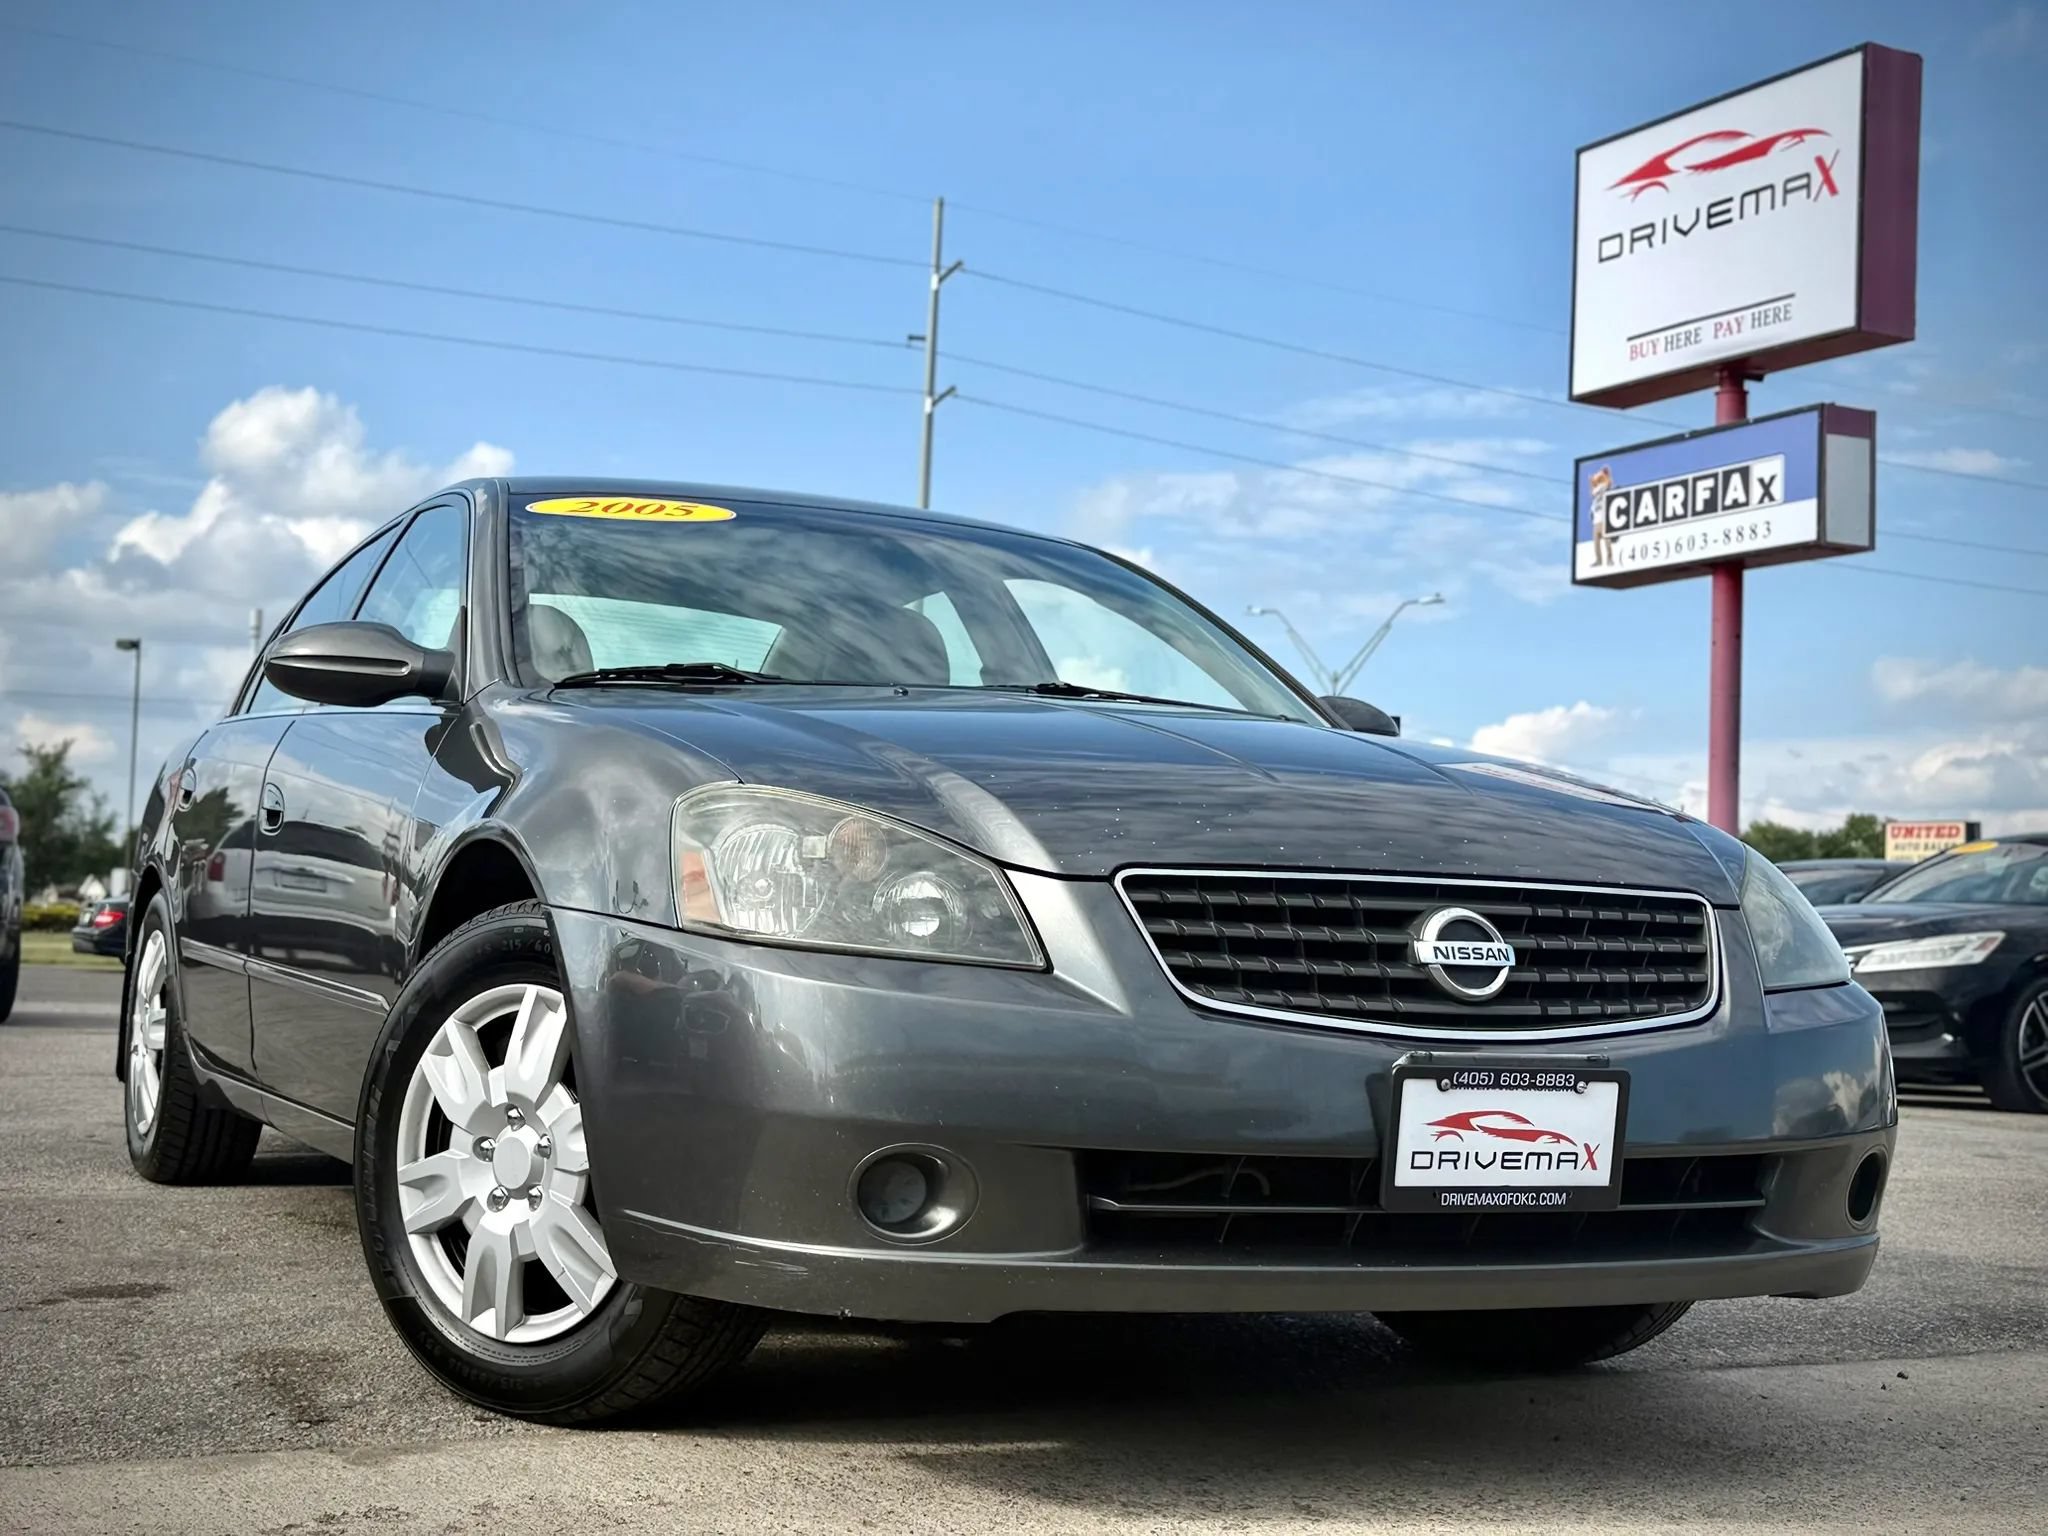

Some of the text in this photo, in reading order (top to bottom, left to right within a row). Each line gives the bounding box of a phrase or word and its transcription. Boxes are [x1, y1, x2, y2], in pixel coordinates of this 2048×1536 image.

[1598, 149, 1840, 264] DRIVEMAX
[1629, 303, 1793, 361] BUY HERE PAY HERE
[566, 501, 699, 517] 2005
[1607, 471, 1779, 530] CARFAX
[1618, 520, 1773, 567] (405)603-8883
[1890, 825, 1961, 839] UNITED
[1433, 945, 1511, 962] NISSAN
[1453, 1071, 1575, 1087] (405) 603-8883
[1410, 1142, 1600, 1171] DRIVEMAX
[1440, 1192, 1567, 1206] DRIVEMAXOFOKC.COM
